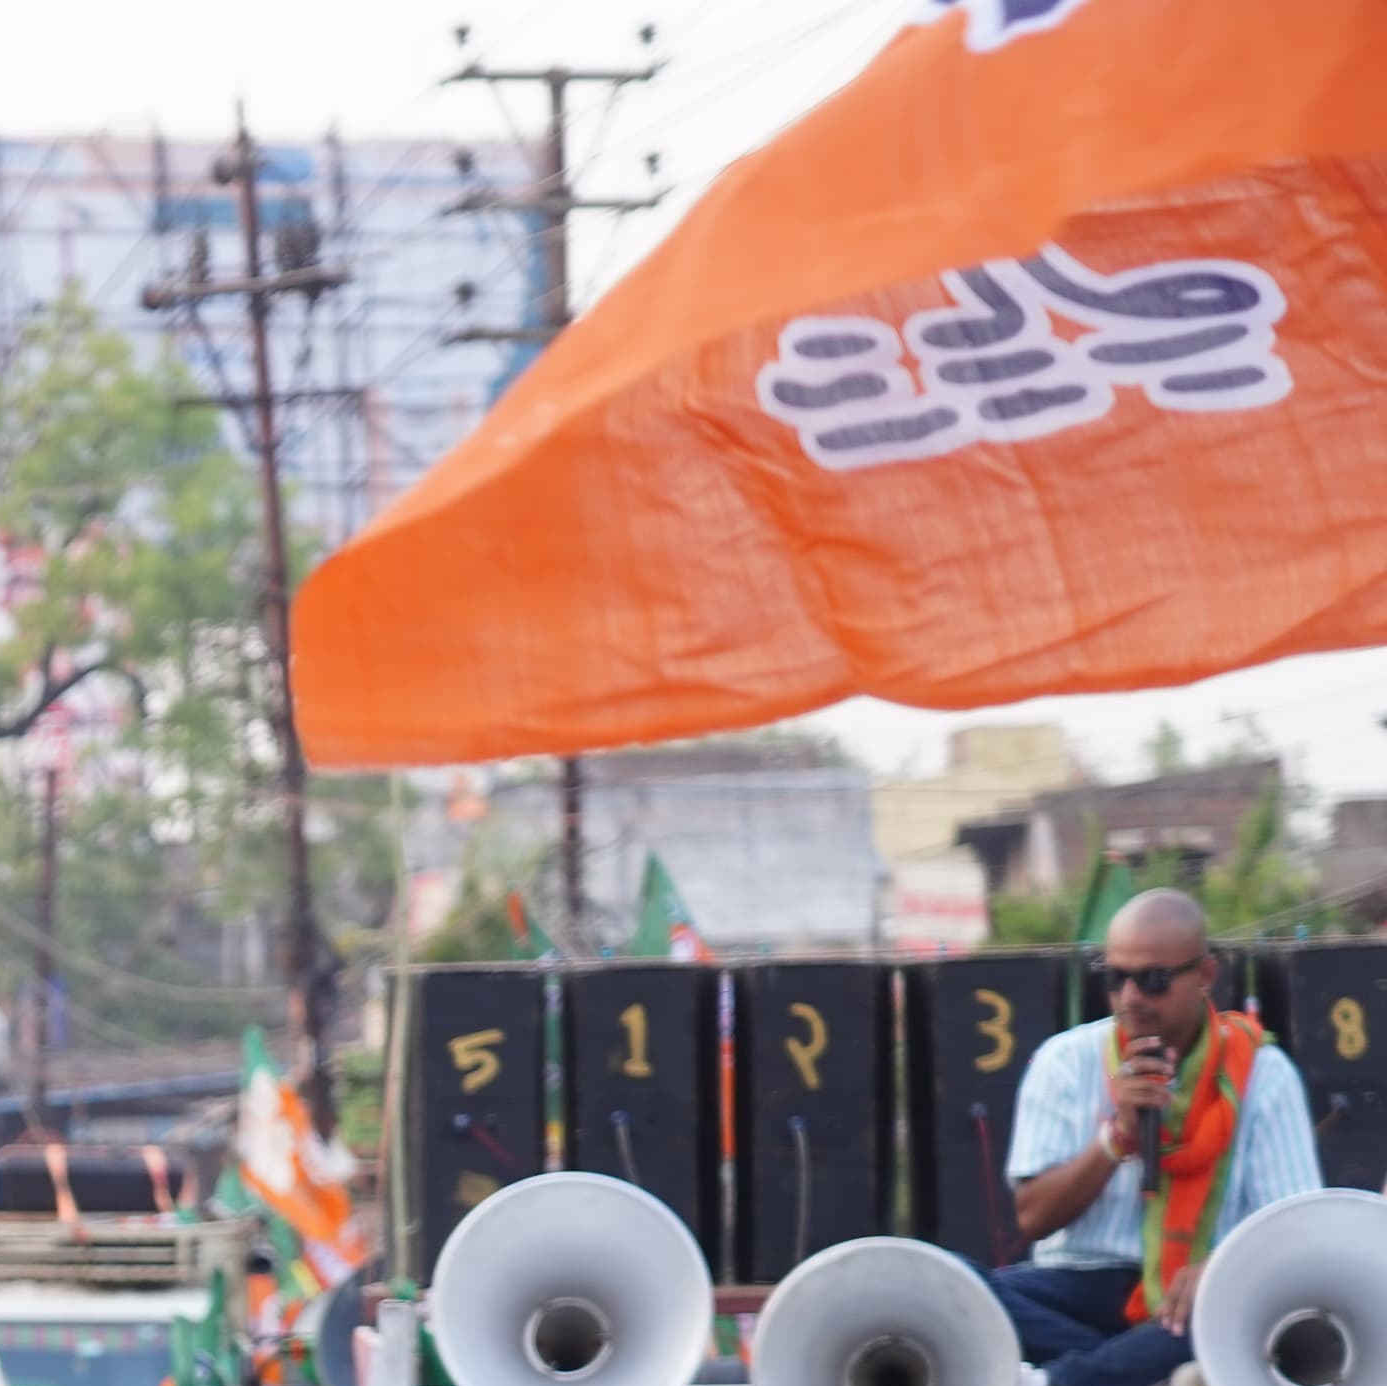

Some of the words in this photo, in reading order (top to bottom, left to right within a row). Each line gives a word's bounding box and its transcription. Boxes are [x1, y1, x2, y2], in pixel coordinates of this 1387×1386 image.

[448, 1028, 505, 1094] 5
[619, 1003, 653, 1077] 1
[1331, 997, 1366, 1059] 8
